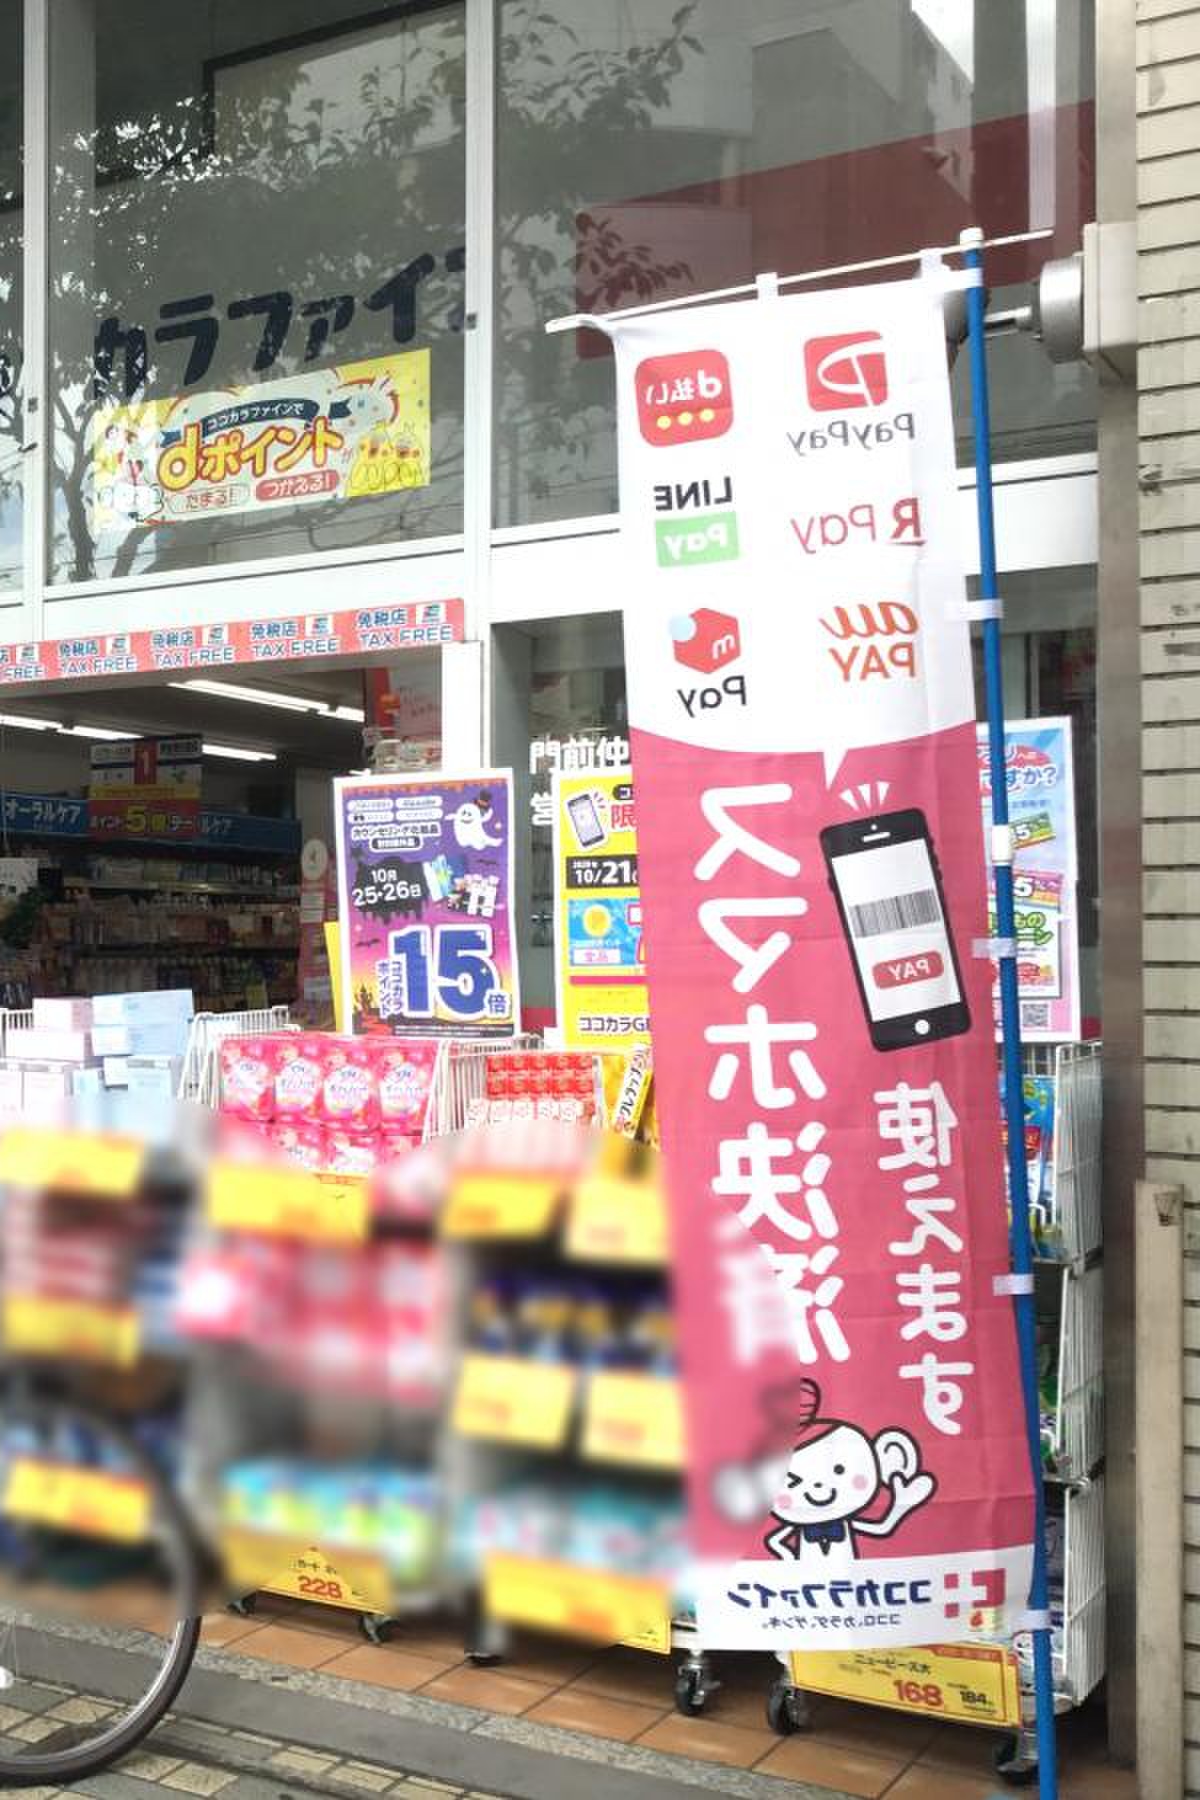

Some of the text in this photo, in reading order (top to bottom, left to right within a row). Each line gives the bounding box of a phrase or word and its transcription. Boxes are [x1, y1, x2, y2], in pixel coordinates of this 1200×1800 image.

[157, 416, 345, 491] dポイント
[361, 625, 452, 649] TAX FREE
[155, 648, 234, 668] TAX FREE
[254, 638, 338, 659] TAX FREE
[4, 665, 45, 681] FREE
[94, 656, 137, 673] FREE
[3, 799, 82, 824] オーラルケア
[372, 868, 398, 883] 10月
[298, 1575, 342, 1600] 228
[893, 1679, 944, 1707] 168
